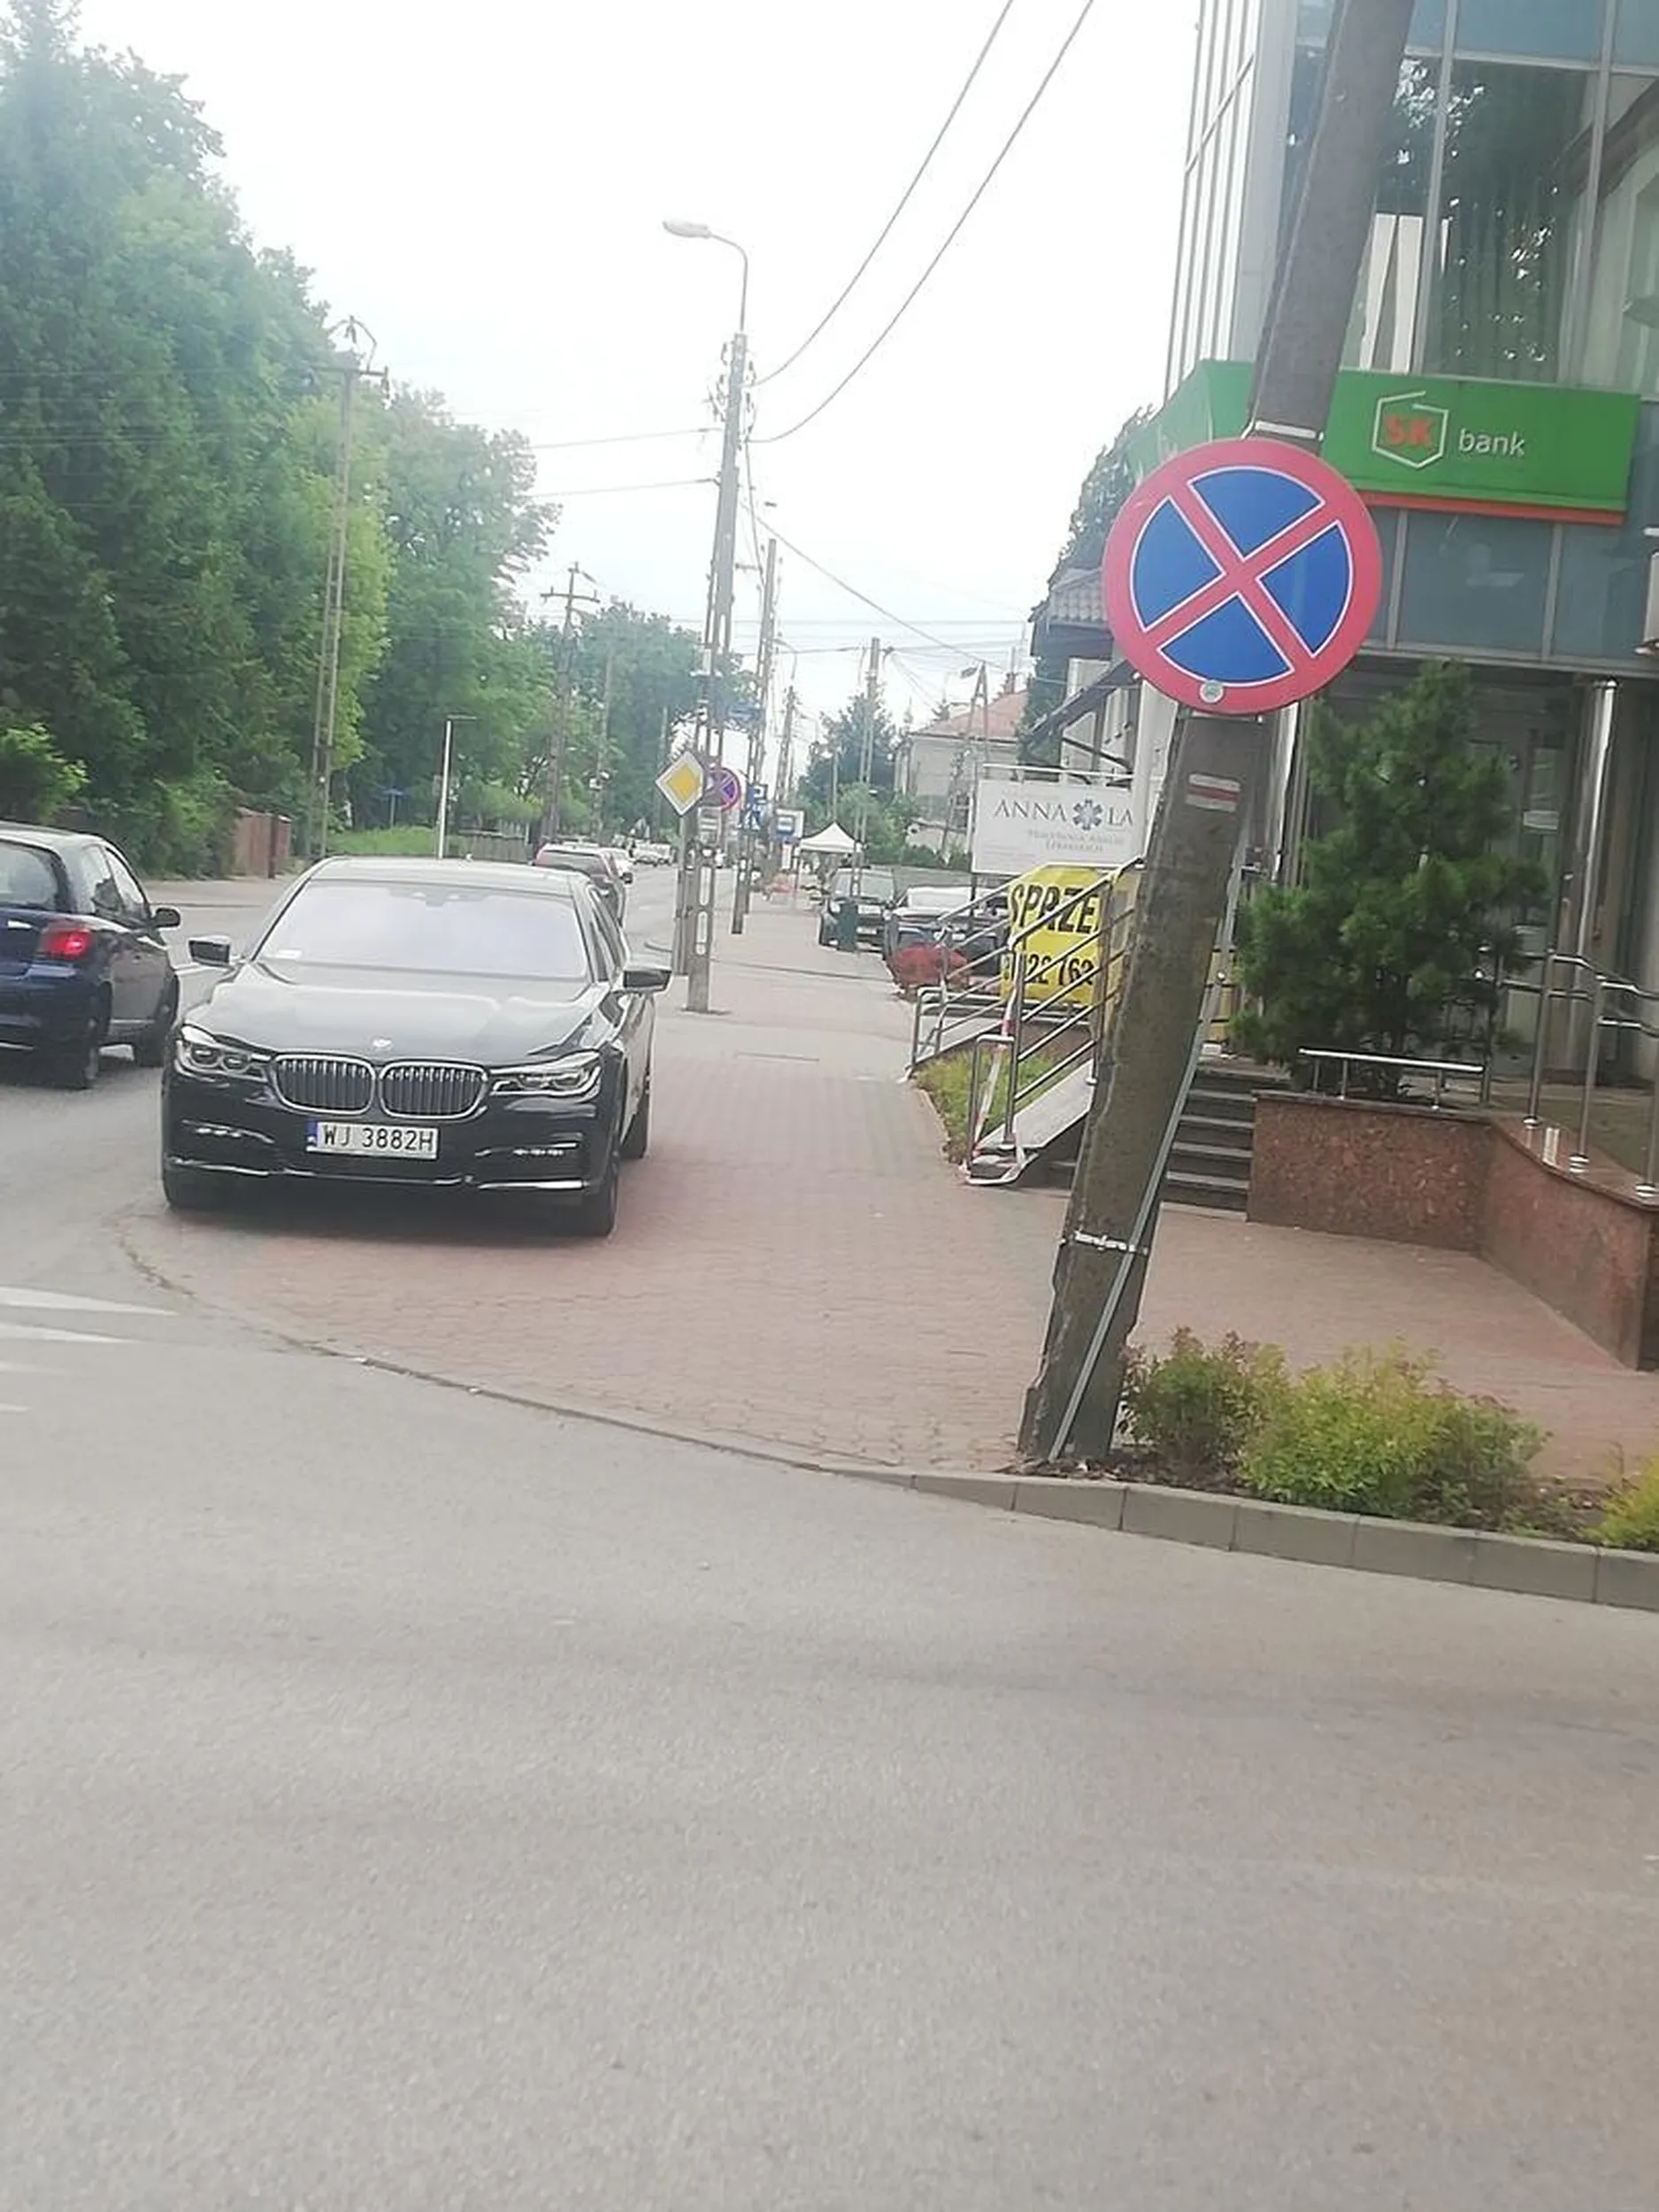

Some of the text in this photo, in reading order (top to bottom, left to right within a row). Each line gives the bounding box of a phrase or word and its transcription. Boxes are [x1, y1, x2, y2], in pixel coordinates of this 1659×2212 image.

[1385, 413, 1525, 456] SK bank
[994, 798, 1067, 823] ANNA
[1011, 884, 1100, 934] SPRZE
[323, 1125, 434, 1151] WJ 3882H
